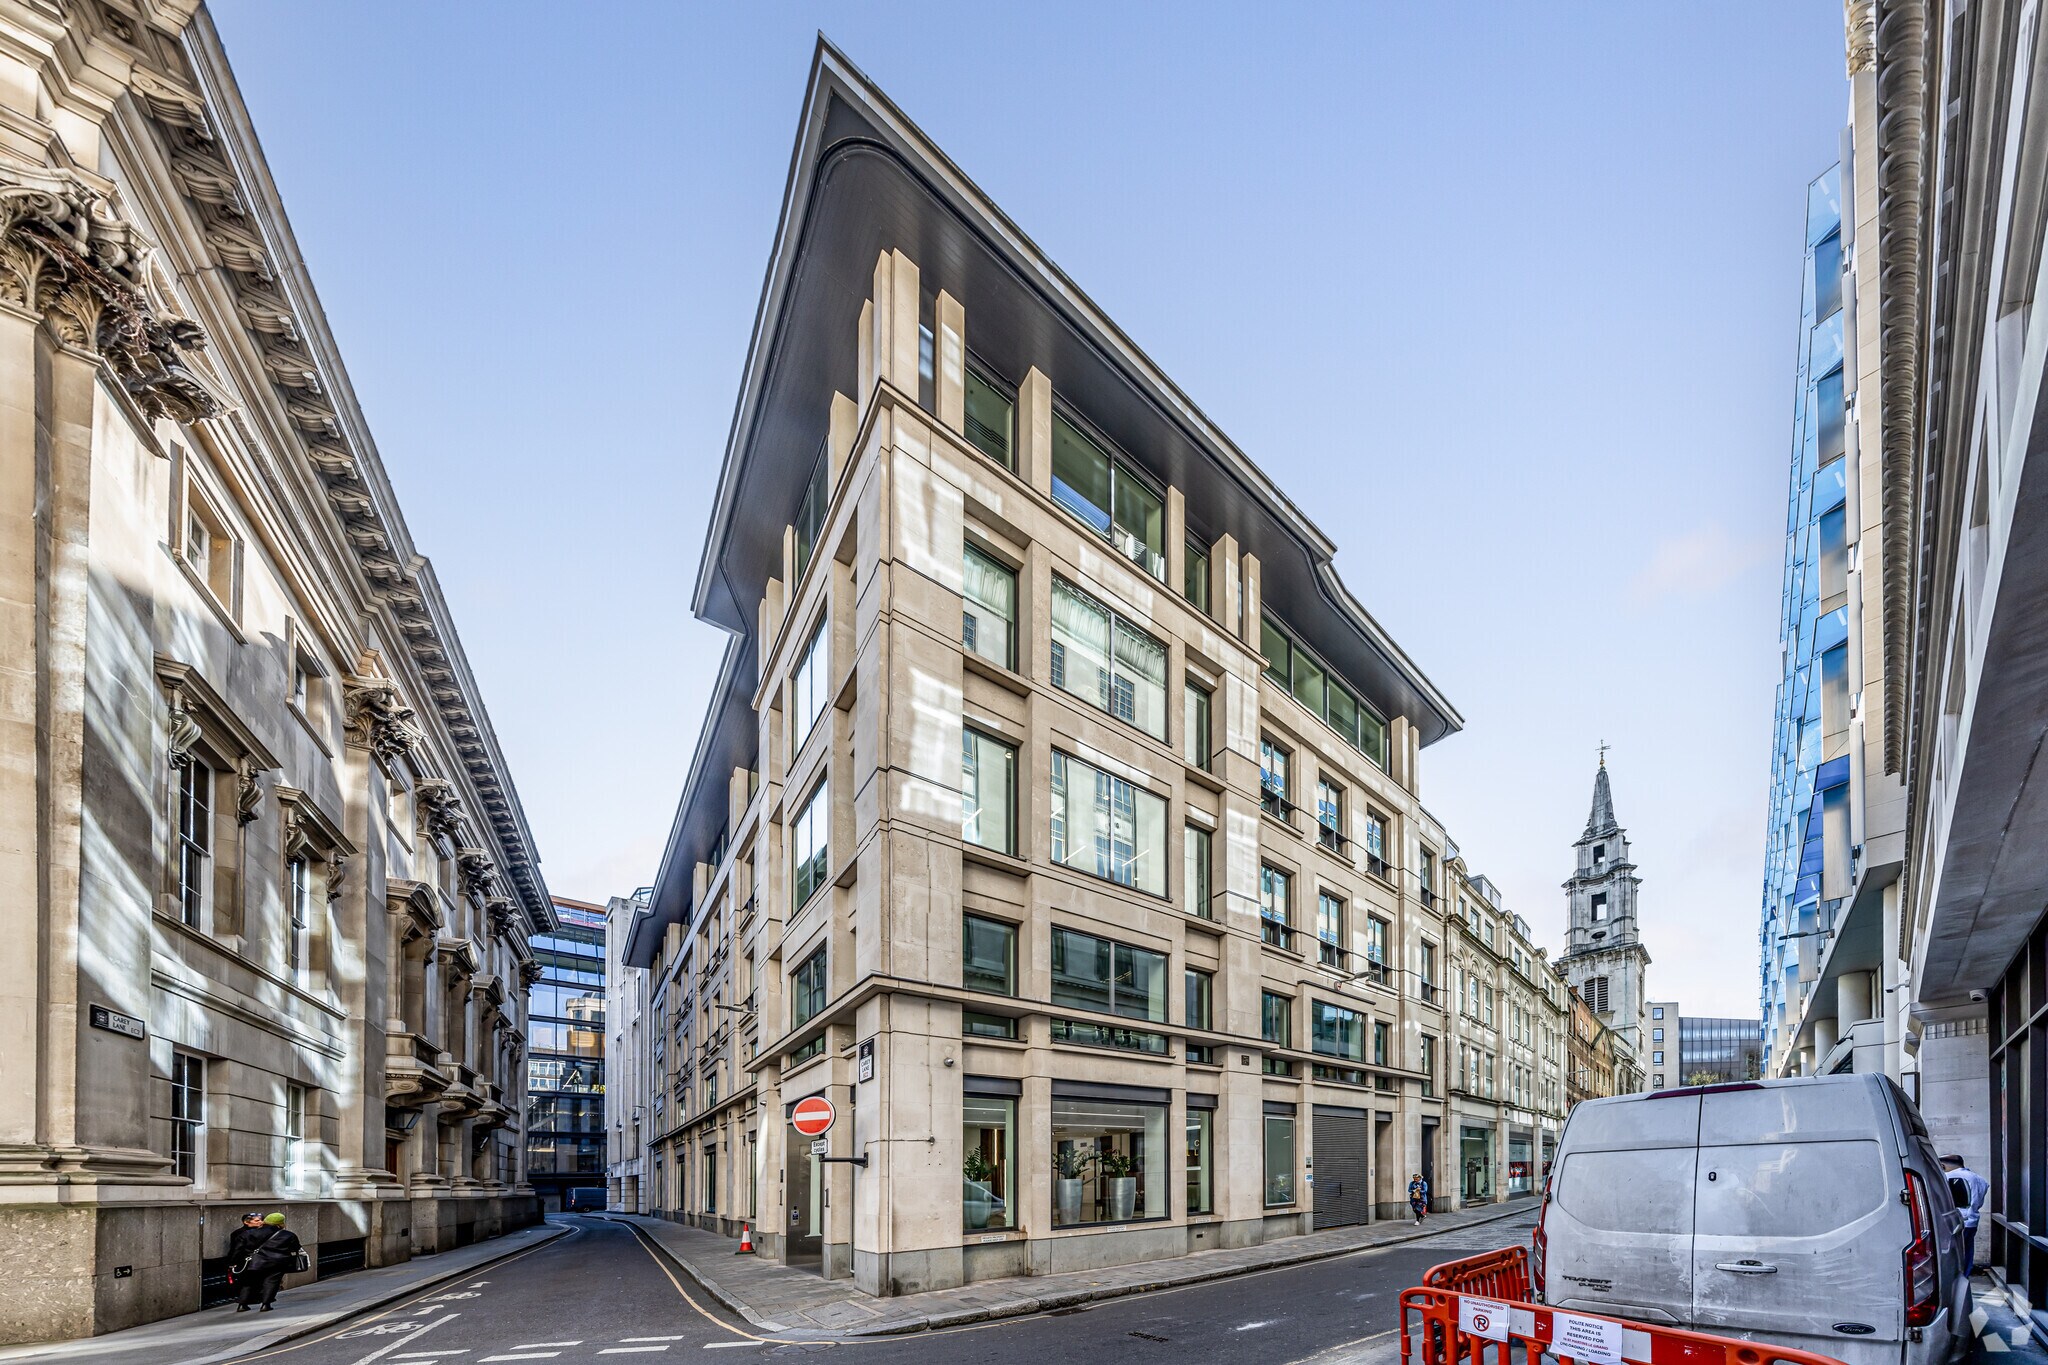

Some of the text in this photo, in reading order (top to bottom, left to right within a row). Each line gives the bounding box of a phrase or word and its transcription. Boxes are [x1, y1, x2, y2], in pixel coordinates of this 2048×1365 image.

[113, 1016, 130, 1025] CAREY
[113, 1022, 126, 1031] LANE
[131, 1027, 140, 1035] EC2
[825, 1188, 830, 1208] 1
[1470, 1300, 1504, 1310] UNAUTHORISED
[1566, 1332, 1592, 1341] RESERVED
[1588, 1348, 1611, 1356] LOADING
